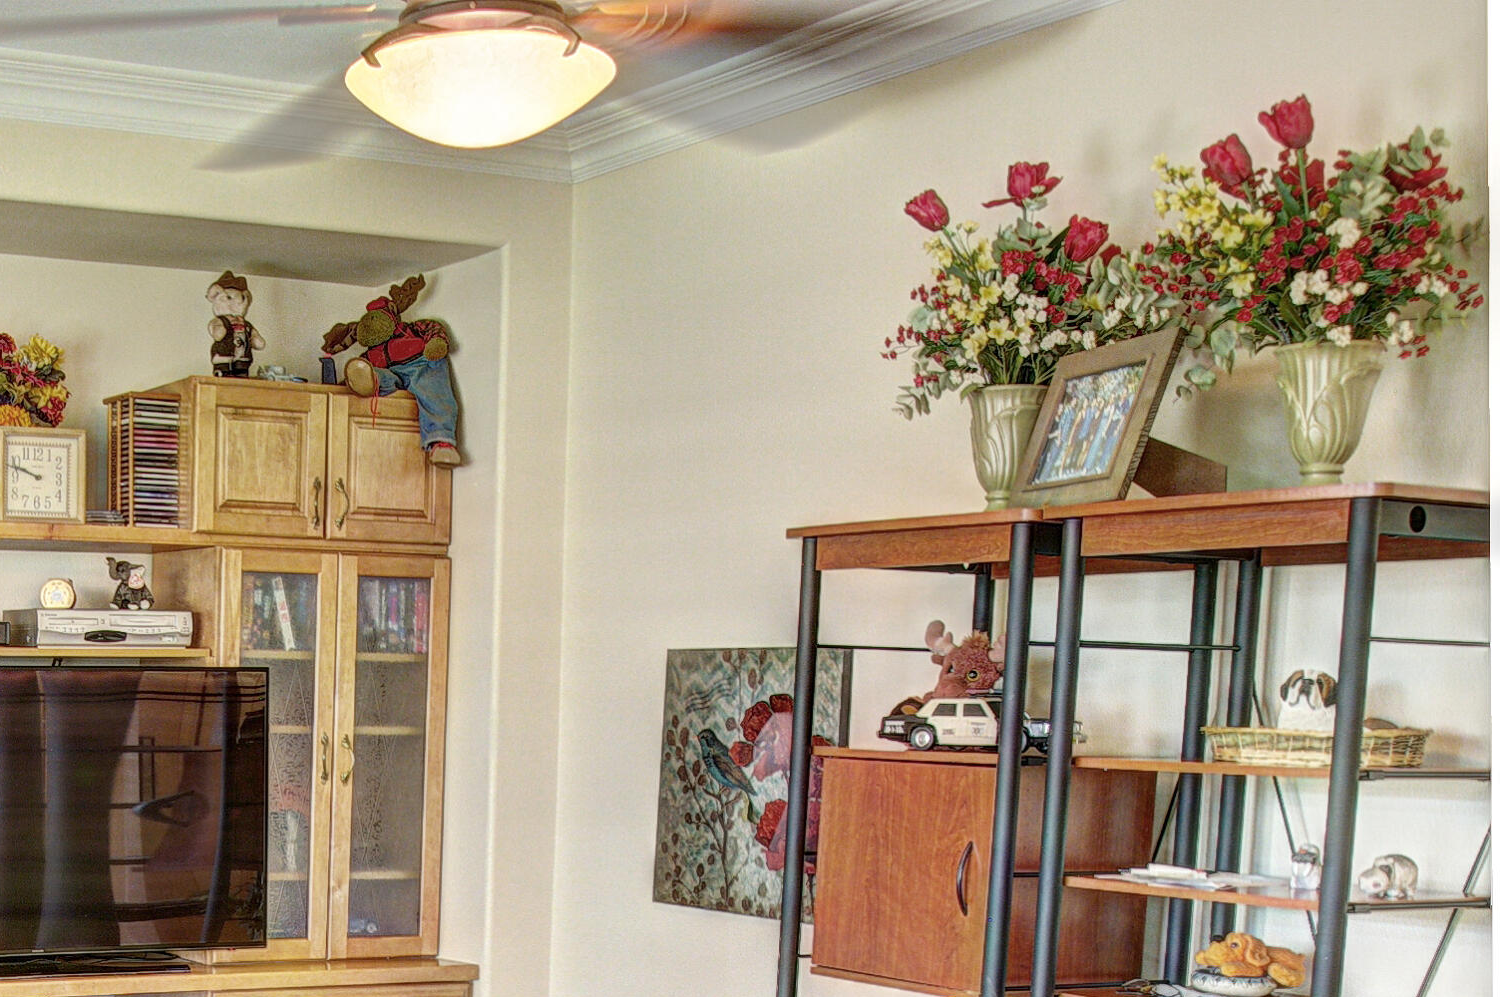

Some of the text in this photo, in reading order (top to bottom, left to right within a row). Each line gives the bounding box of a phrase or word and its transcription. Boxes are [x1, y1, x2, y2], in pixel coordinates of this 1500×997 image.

[23, 447, 52, 463] 11 12 1
[55, 456, 62, 470] 2
[12, 471, 19, 483] 9
[55, 473, 62, 487] 3
[11, 487, 19, 500] 8
[55, 489, 62, 503] 4
[22, 495, 51, 509] 7 6 5
